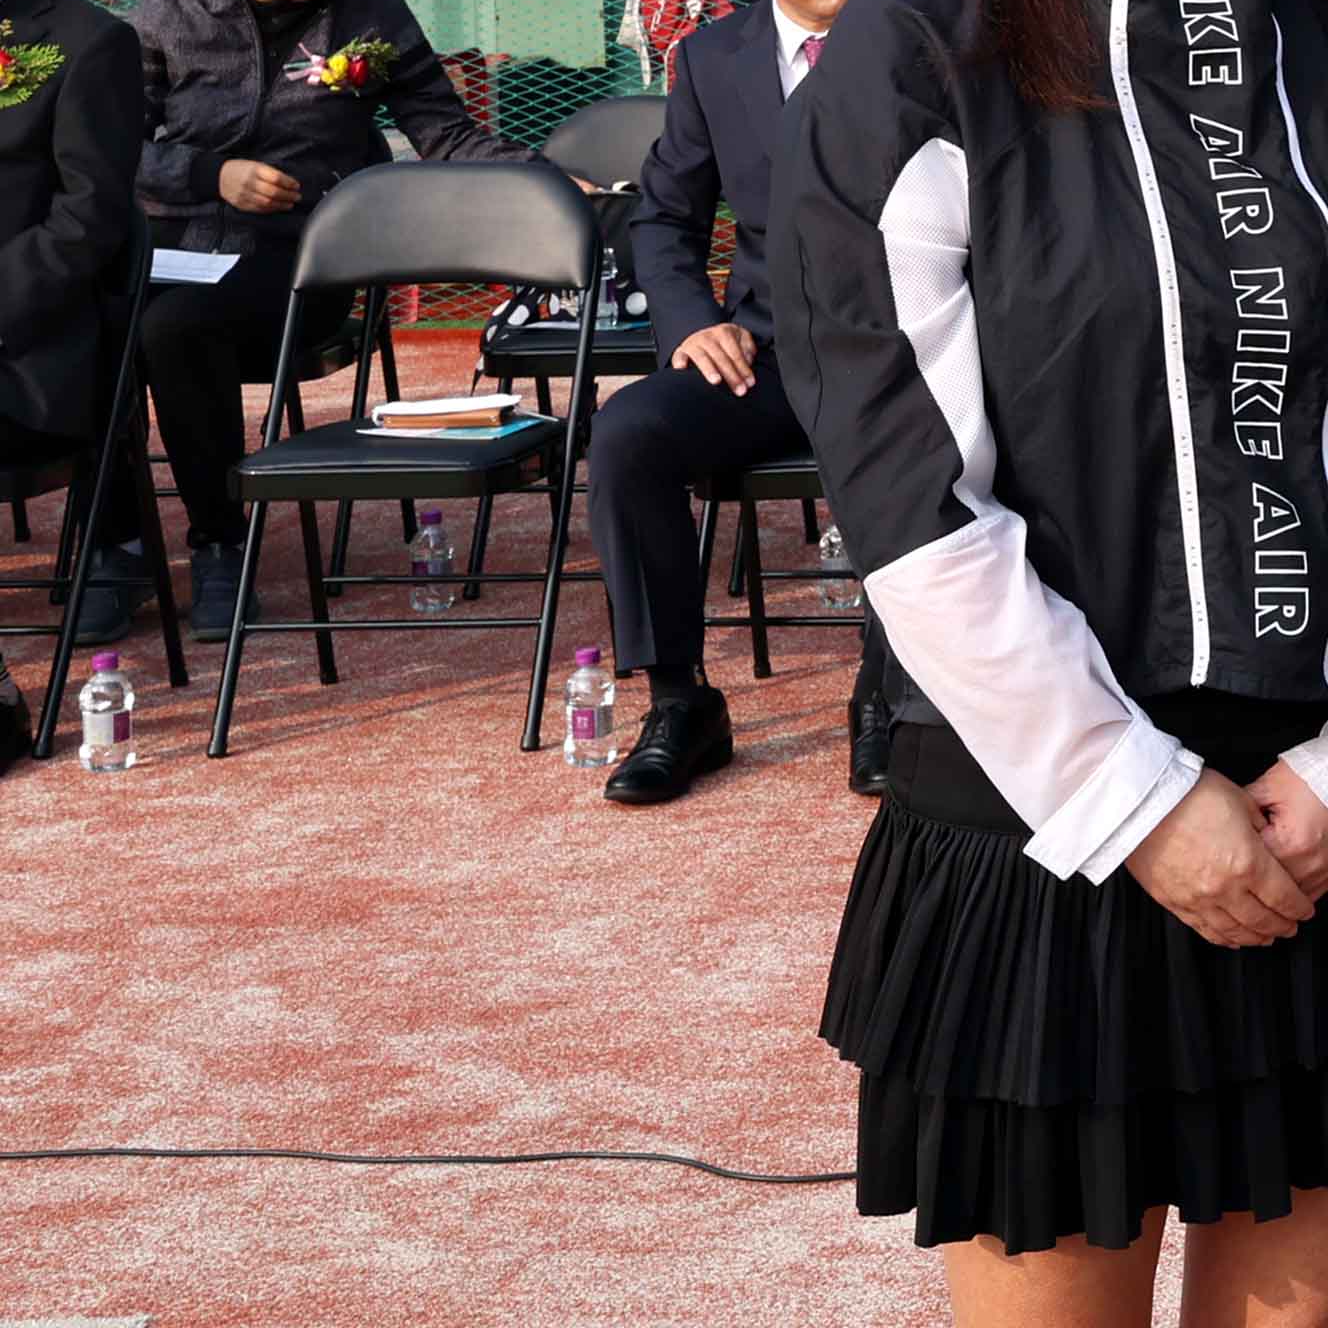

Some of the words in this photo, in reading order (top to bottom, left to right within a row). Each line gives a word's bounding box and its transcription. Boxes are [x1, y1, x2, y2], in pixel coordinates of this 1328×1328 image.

[1188, 112, 1275, 240] AIR
[1229, 266, 1292, 461] NIKE
[1251, 481, 1311, 639] AIR
